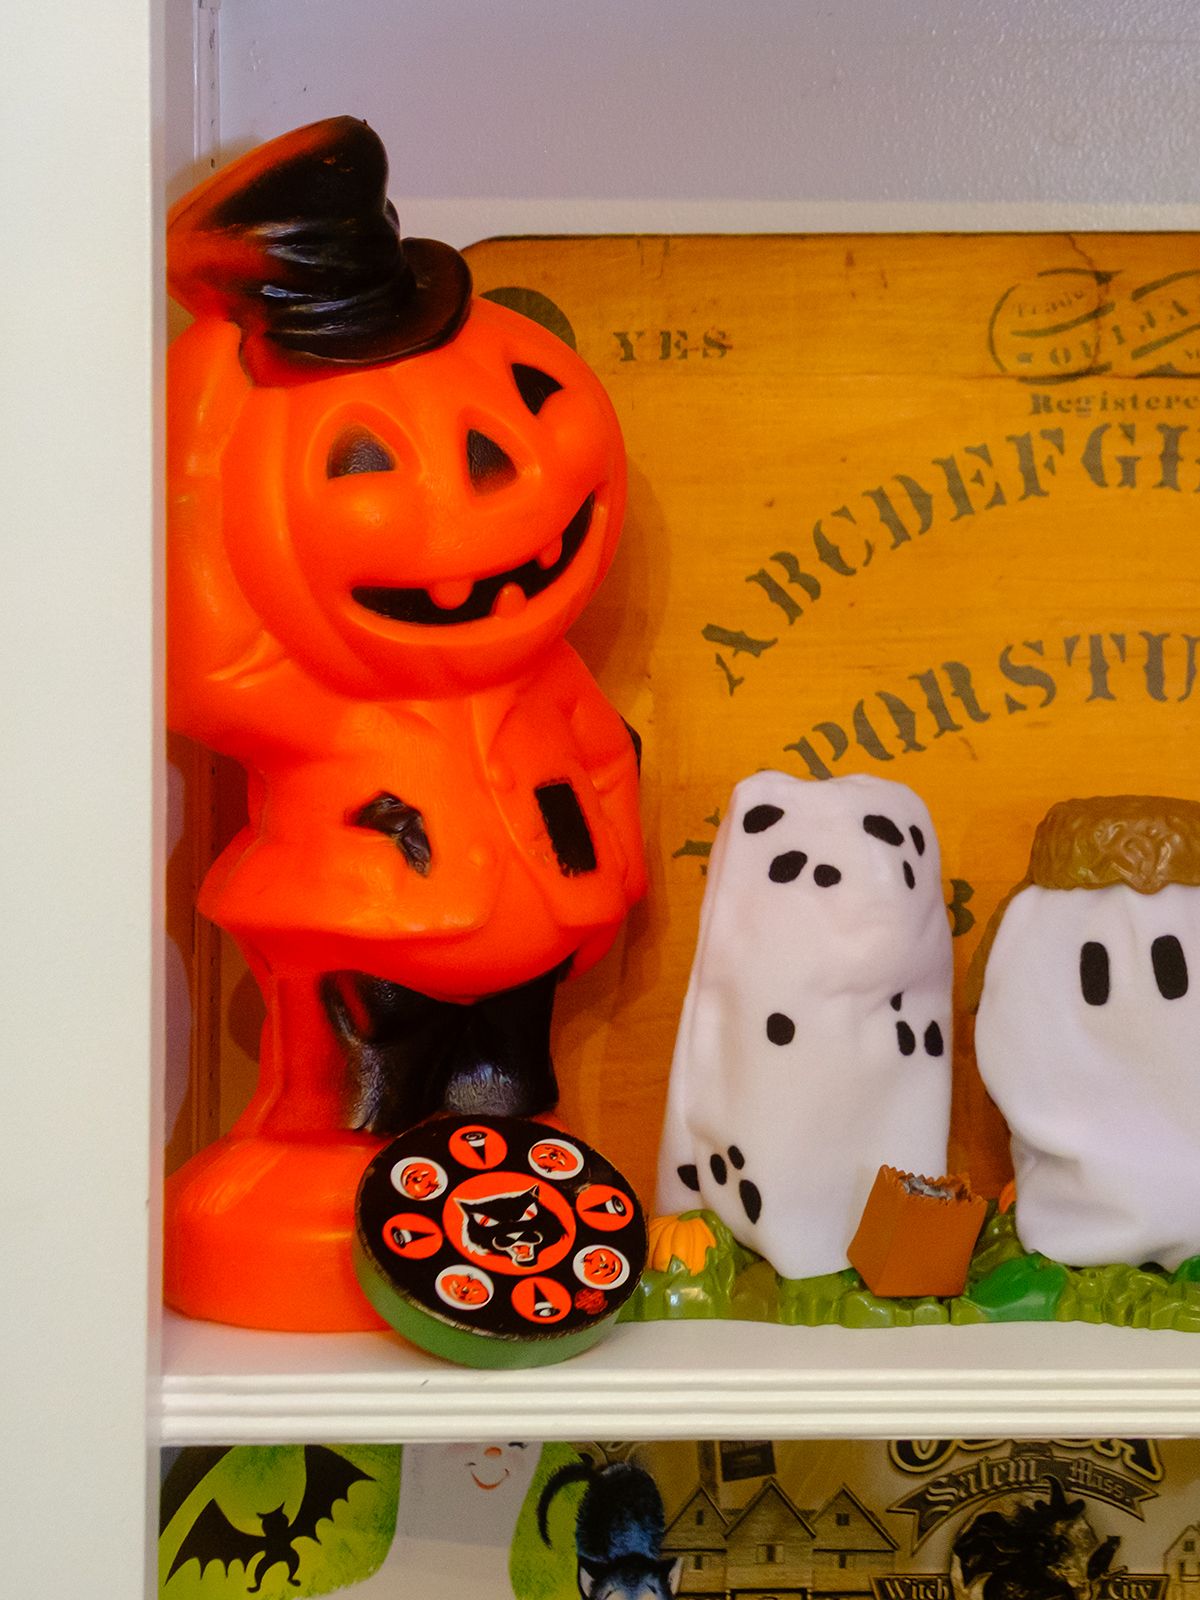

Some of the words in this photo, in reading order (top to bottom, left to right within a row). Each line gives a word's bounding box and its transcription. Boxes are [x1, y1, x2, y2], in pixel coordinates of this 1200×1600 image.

[613, 330, 729, 361] YES
[923, 1456, 1038, 1521] Salem
[1067, 1458, 1135, 1504] Mass.
[884, 1577, 949, 1600] Witch
[1107, 1577, 1154, 1600] City
